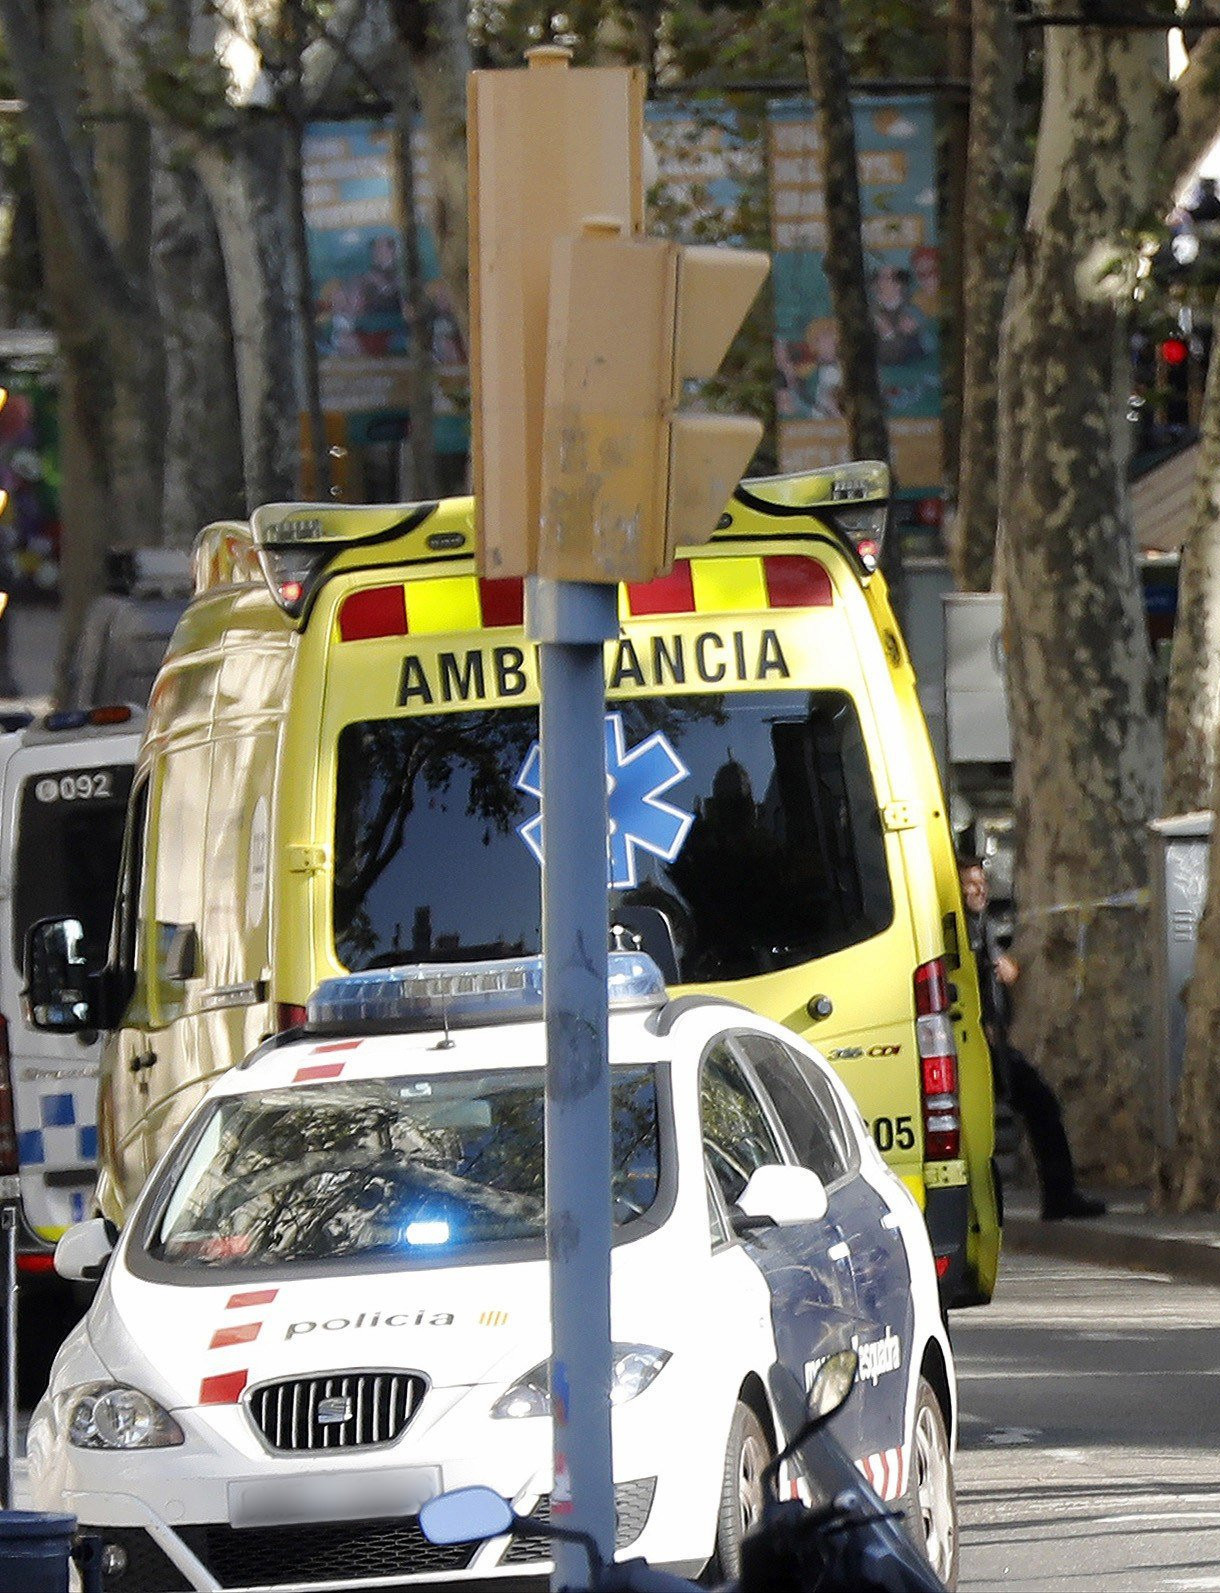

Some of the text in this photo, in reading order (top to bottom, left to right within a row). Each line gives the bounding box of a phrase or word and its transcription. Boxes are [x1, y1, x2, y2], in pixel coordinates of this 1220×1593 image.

[395, 627, 790, 707] AMBÀNCIA
[867, 1045, 902, 1057] CDI
[863, 1115, 915, 1151] 05
[284, 1309, 456, 1341] policia
